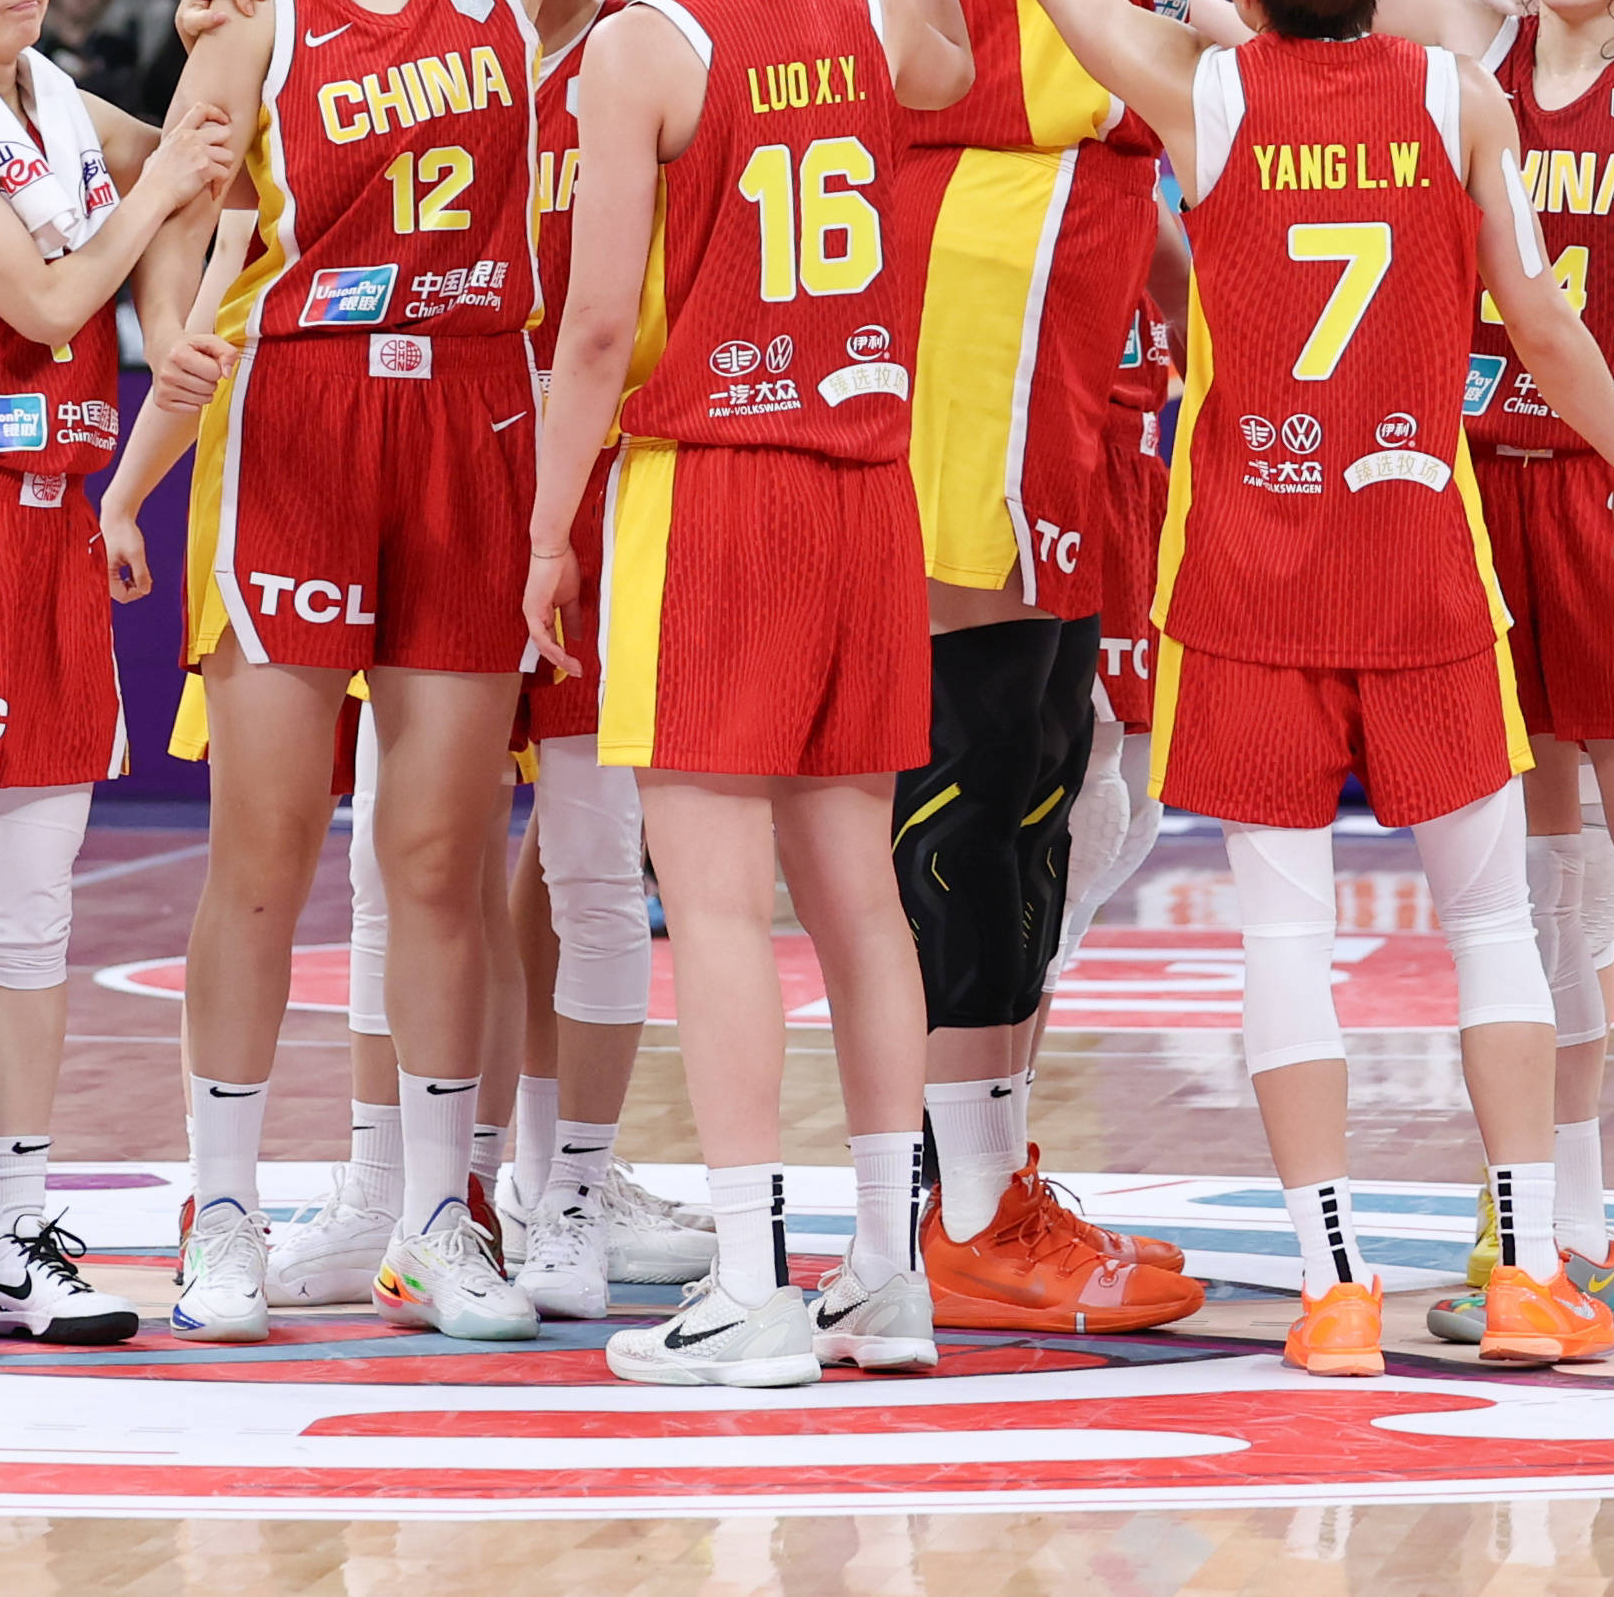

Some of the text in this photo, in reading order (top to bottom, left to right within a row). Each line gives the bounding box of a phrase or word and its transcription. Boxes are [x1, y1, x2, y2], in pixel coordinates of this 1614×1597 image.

[317, 45, 512, 145] CHINA
[747, 62, 810, 114] LUO
[1253, 142, 1430, 190] YANG L.W.
[384, 145, 474, 234] 12
[738, 135, 884, 303] 16
[316, 280, 386, 301] UnionPay
[338, 295, 379, 311] 银联
[405, 301, 445, 319] China
[1287, 222, 1392, 381] 7
[852, 334, 883, 351] 伊利
[708, 400, 802, 418] FAW-VOLKSWAGEN
[1503, 397, 1548, 417] China
[1381, 422, 1410, 438] 伊利
[1034, 518, 1082, 574] TC
[249, 571, 375, 625] TCL
[1099, 638, 1148, 680] TC
